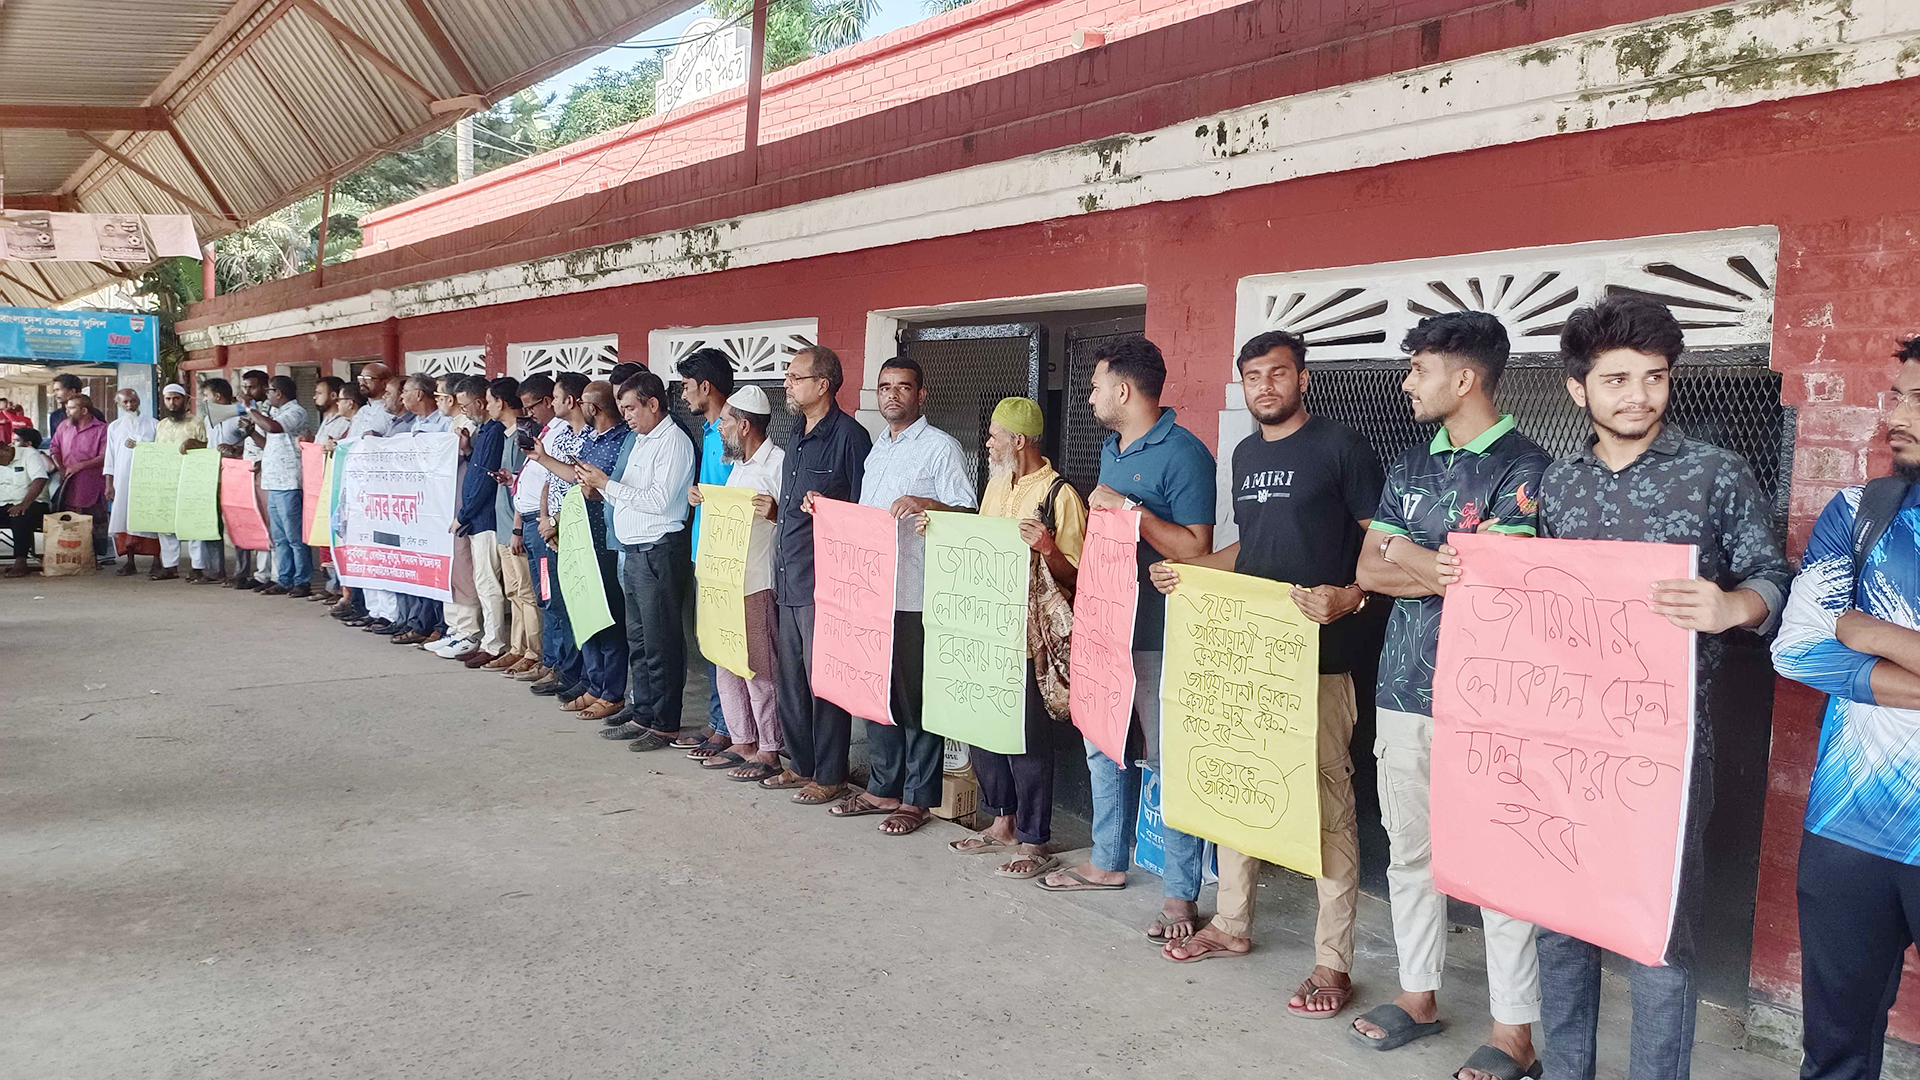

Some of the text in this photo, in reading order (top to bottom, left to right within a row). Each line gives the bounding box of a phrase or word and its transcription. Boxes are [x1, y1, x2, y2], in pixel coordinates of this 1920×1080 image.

[83, 317, 107, 330] পুলিশ
[107, 333, 131, 347] Spa
[1241, 470, 1295, 491] AMIRI
[822, 536, 888, 578] আমাদের
[829, 571, 880, 612] দাবি
[931, 591, 992, 626] লোকাল
[1179, 593, 1246, 622] জাগো
[937, 633, 990, 680] পুনরায়
[936, 676, 1021, 718] করতে হবে
[1456, 656, 1593, 718] লোকাল
[1455, 731, 1681, 812] চালু করতে
[1489, 802, 1588, 874] হবে
